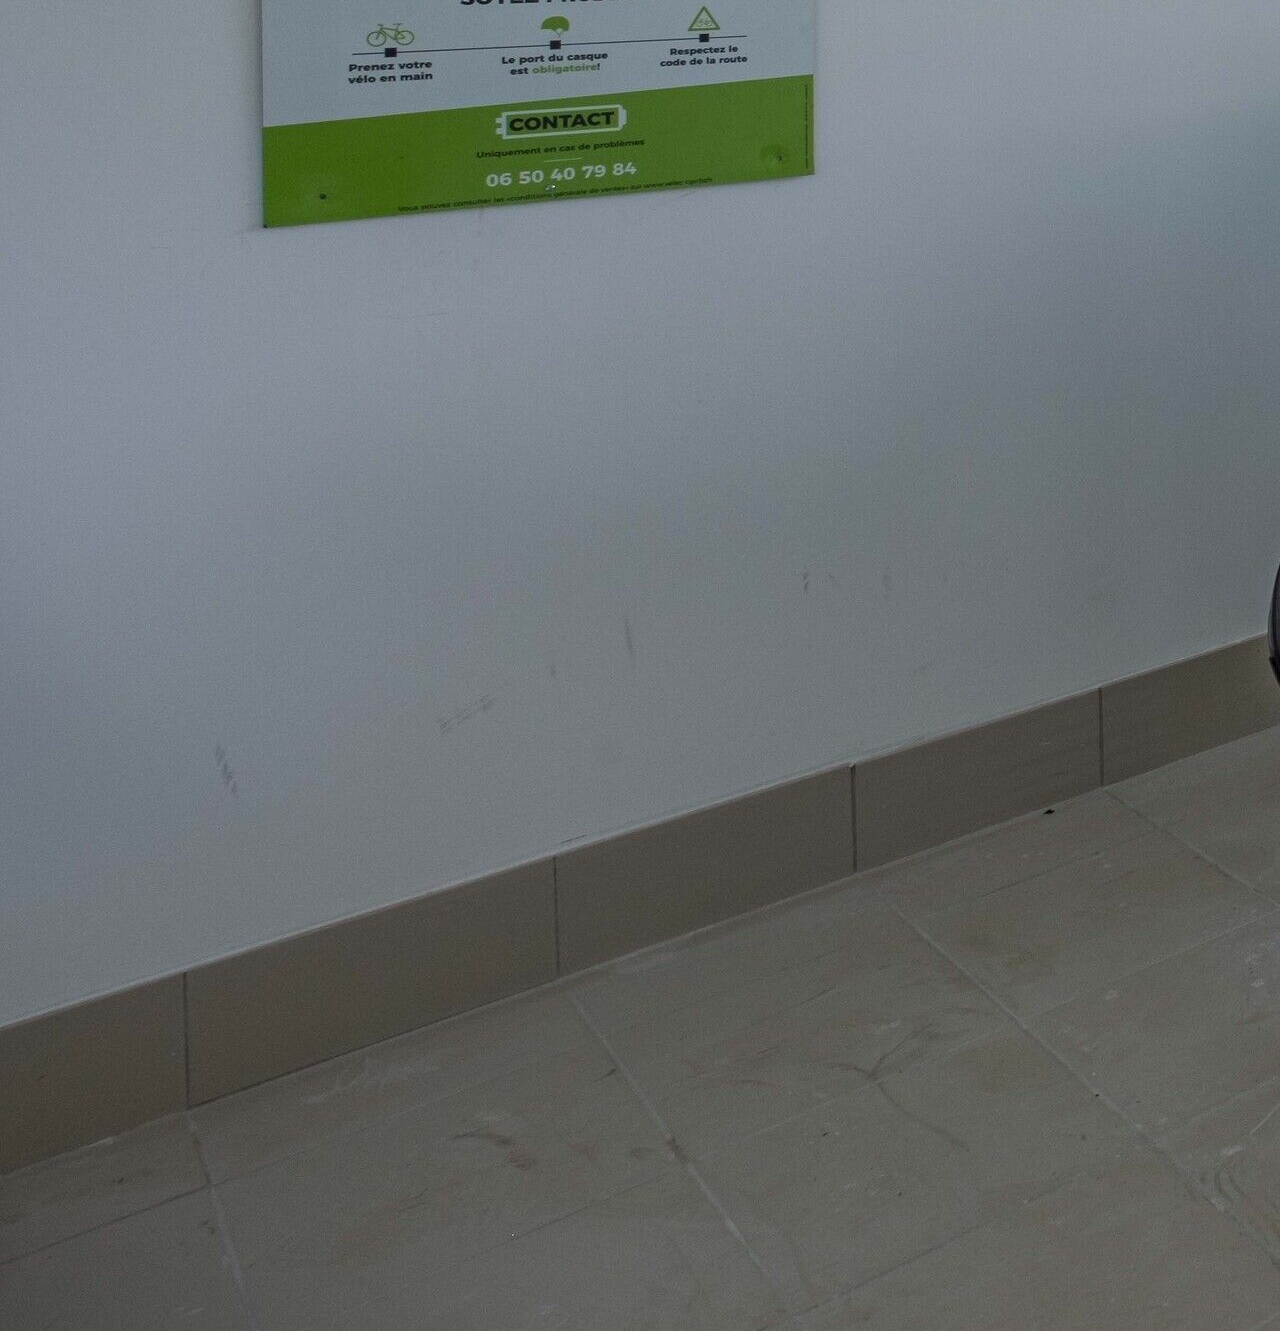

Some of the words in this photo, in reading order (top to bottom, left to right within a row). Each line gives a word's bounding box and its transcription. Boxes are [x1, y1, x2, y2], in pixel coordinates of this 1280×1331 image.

[669, 46, 726, 57] Respectez
[728, 44, 739, 54] le
[501, 55, 517, 65] Le
[519, 54, 546, 66] port
[548, 52, 565, 63] du
[567, 51, 609, 63] casque
[659, 58, 687, 68] code
[689, 57, 703, 67] de
[705, 57, 717, 66] la
[719, 55, 748, 65] route
[348, 62, 395, 72] Prenez
[398, 60, 434, 70] votre
[510, 66, 529, 76] est
[532, 63, 601, 76] obligatoire!
[348, 73, 376, 84] vélo
[380, 74, 397, 83] en
[400, 71, 434, 82] main
[508, 111, 615, 132] CONTACT
[476, 147, 542, 160] Uniquement
[543, 145, 557, 154] en
[559, 144, 576, 153] cas
[578, 142, 592, 151] de
[593, 139, 645, 151] problèmes
[486, 172, 513, 188] 06
[518, 170, 545, 185] 50
[551, 167, 576, 182] 40
[582, 164, 607, 179] 79
[612, 161, 638, 177] 84
